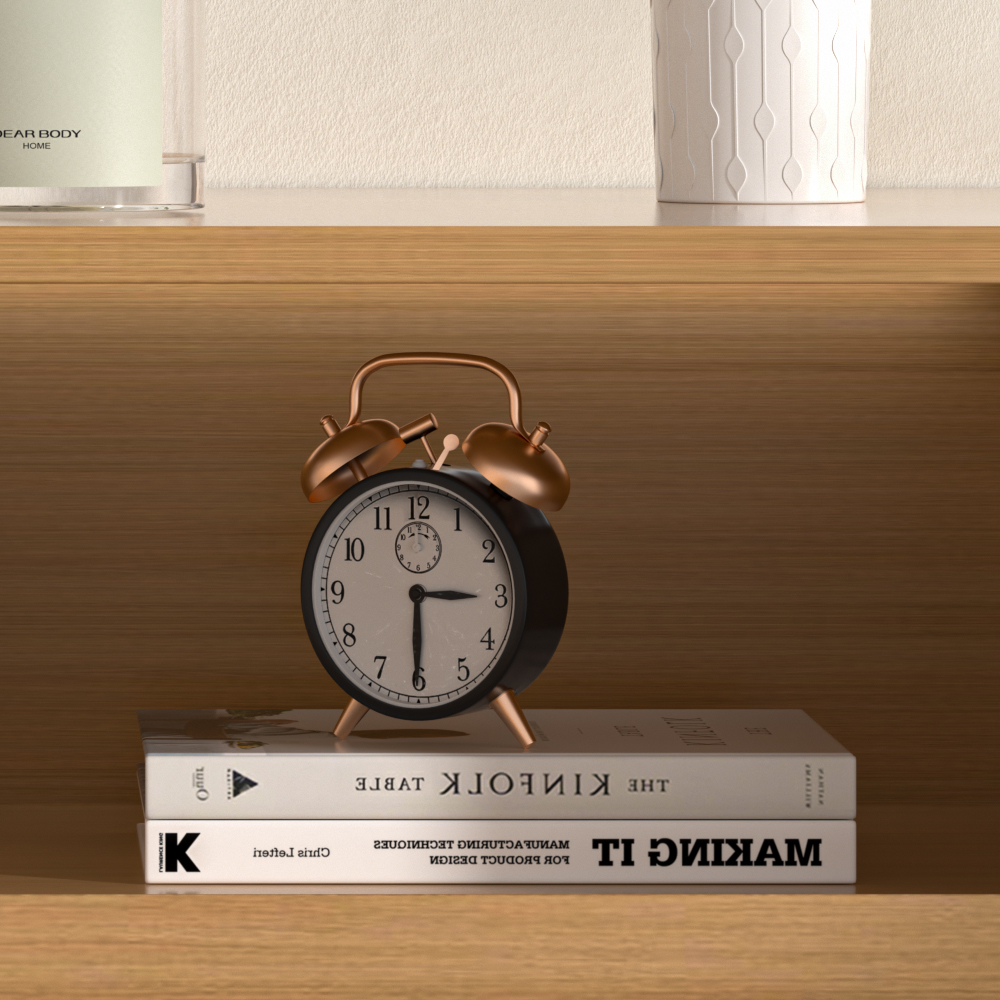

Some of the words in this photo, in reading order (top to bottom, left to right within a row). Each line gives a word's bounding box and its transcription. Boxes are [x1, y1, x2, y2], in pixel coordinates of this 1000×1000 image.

[39, 130, 81, 138] BODY
[374, 507, 392, 530] 11
[408, 496, 430, 520] 12
[454, 507, 463, 531] 1
[345, 538, 364, 561] 10
[482, 539, 496, 563] 2
[331, 580, 344, 604] 9
[495, 584, 508, 608] 3
[343, 623, 357, 647] 8
[480, 628, 495, 650] 4
[374, 656, 387, 679] 7
[412, 667, 426, 691] 6
[458, 657, 471, 681] 5
